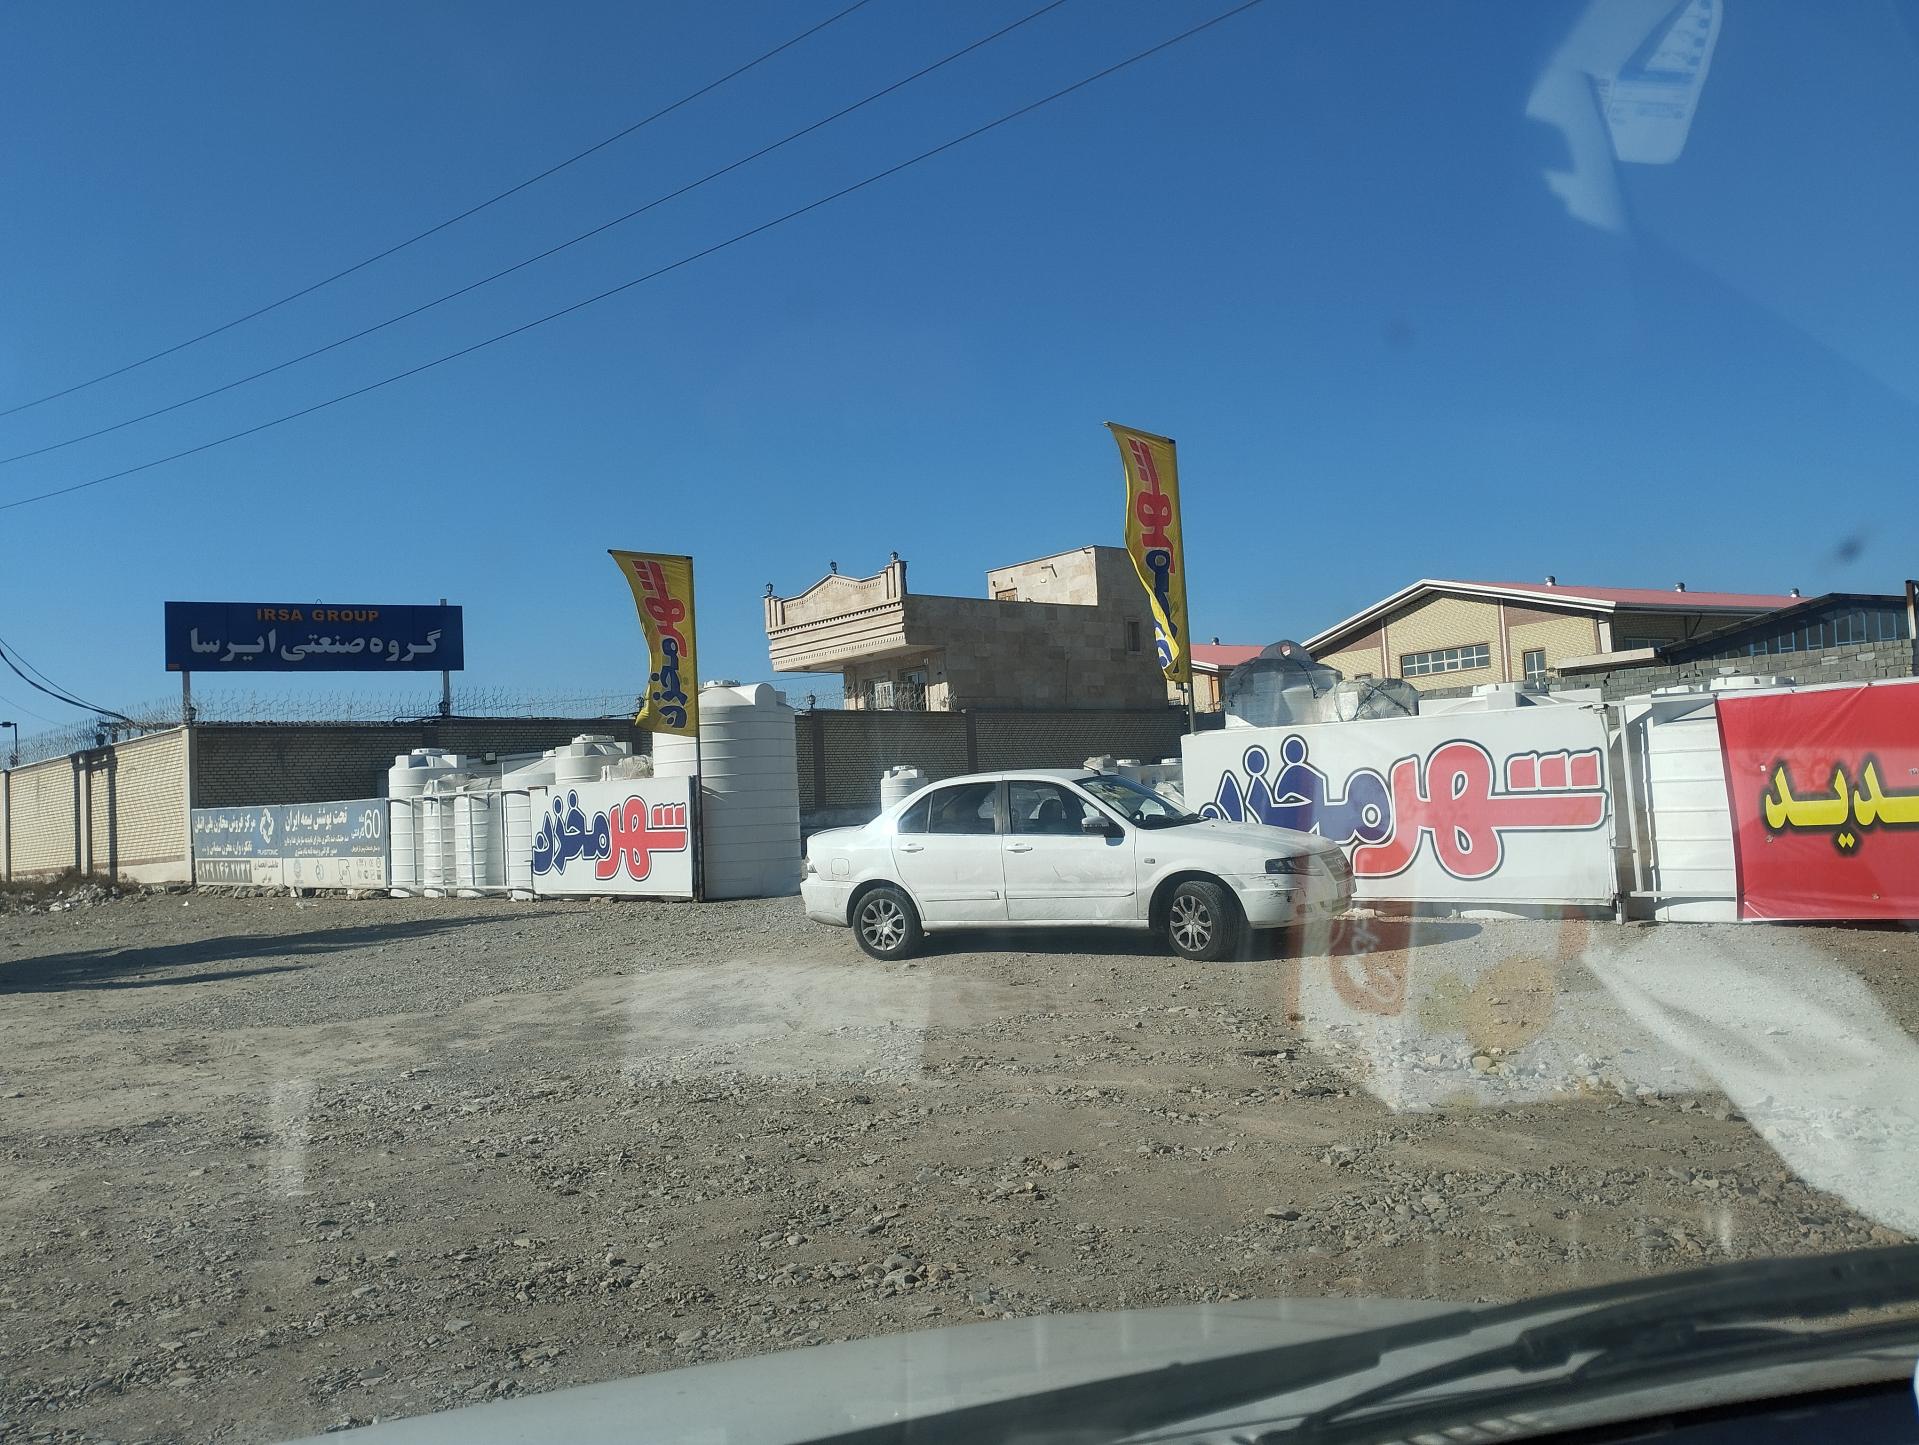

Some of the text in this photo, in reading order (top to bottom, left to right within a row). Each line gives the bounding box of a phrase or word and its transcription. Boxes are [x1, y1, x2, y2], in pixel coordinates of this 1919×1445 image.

[190, 627, 442, 662] گروه صنعتی ایرسا
[256, 608, 380, 622] IRSA GROUP
[632, 560, 688, 729] شهر مخزن
[365, 809, 381, 838] 60
[532, 789, 688, 882] شهر مخزن
[1352, 739, 1608, 880] شهر
[1765, 760, 1919, 849] دید
